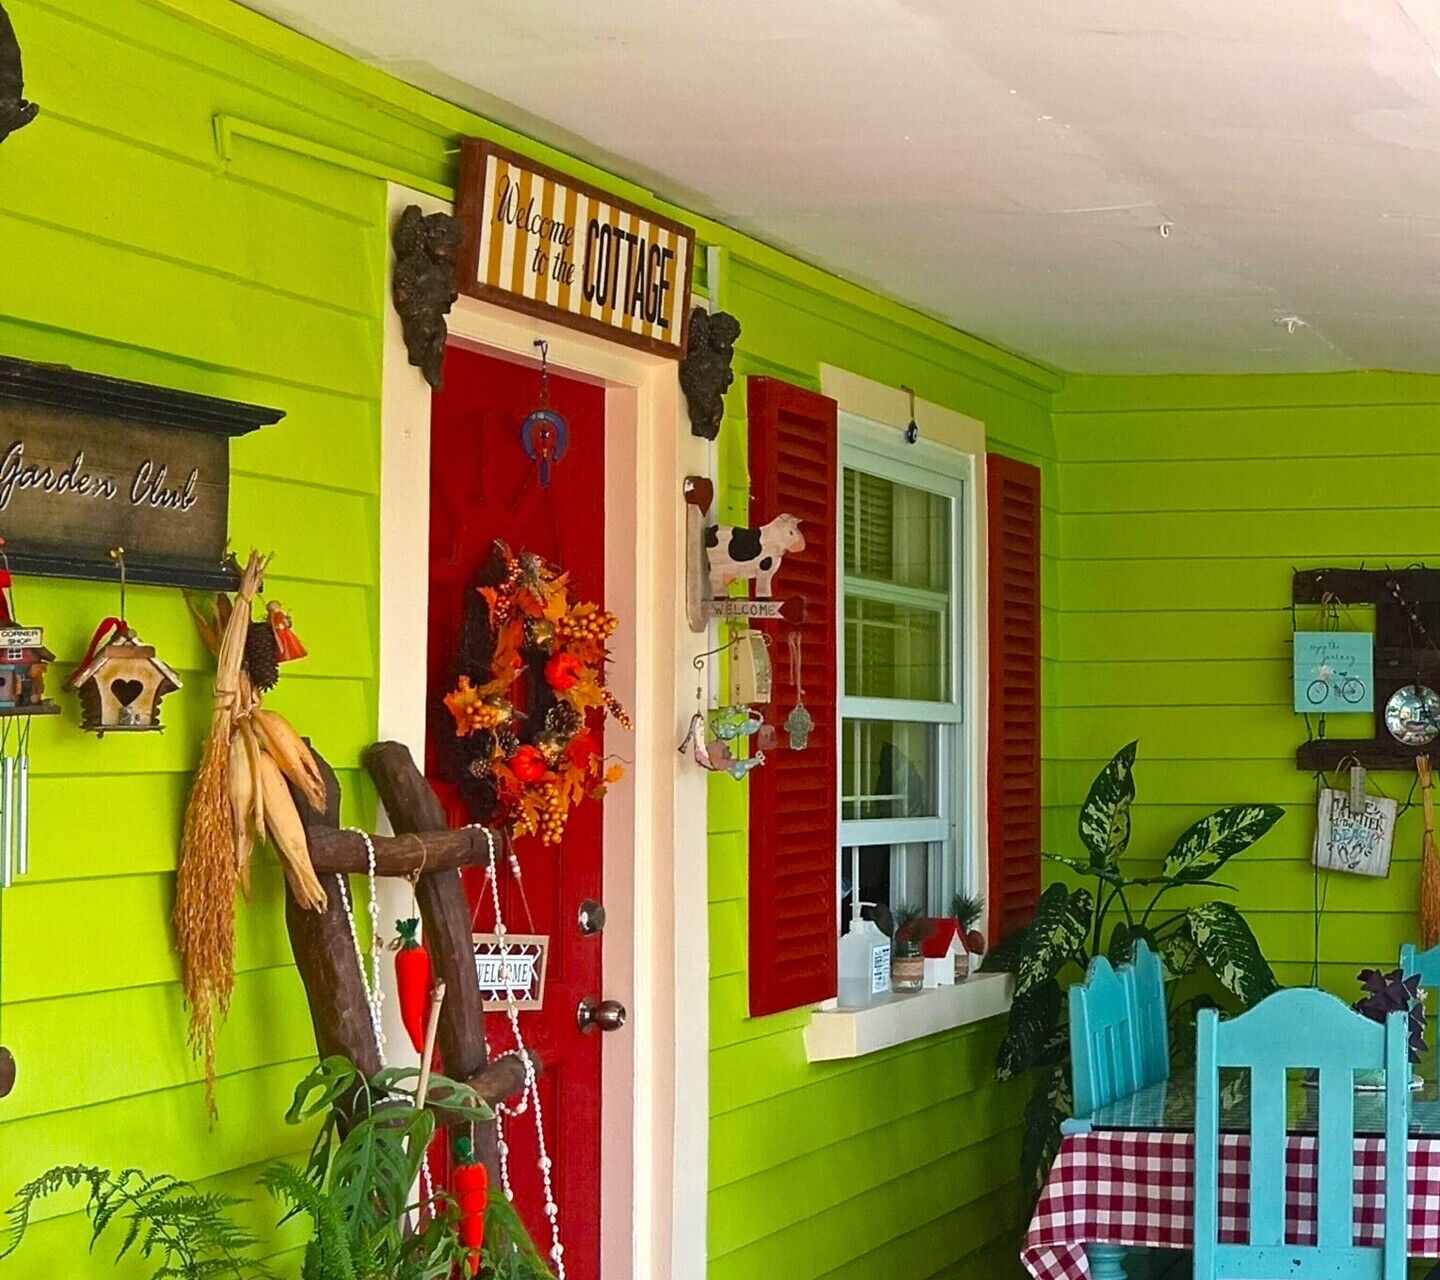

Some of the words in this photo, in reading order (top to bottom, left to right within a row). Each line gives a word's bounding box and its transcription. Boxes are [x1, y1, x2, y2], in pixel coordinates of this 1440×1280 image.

[497, 174, 574, 247] Welcome
[531, 243, 550, 276] to
[551, 249, 576, 286] the
[582, 217, 675, 328] COTTAGE
[0, 440, 117, 511] Garden
[130, 458, 199, 512] Club
[711, 602, 777, 617] WELCOME
[1, 630, 38, 638] CORNER
[8, 637, 32, 646] SHOP
